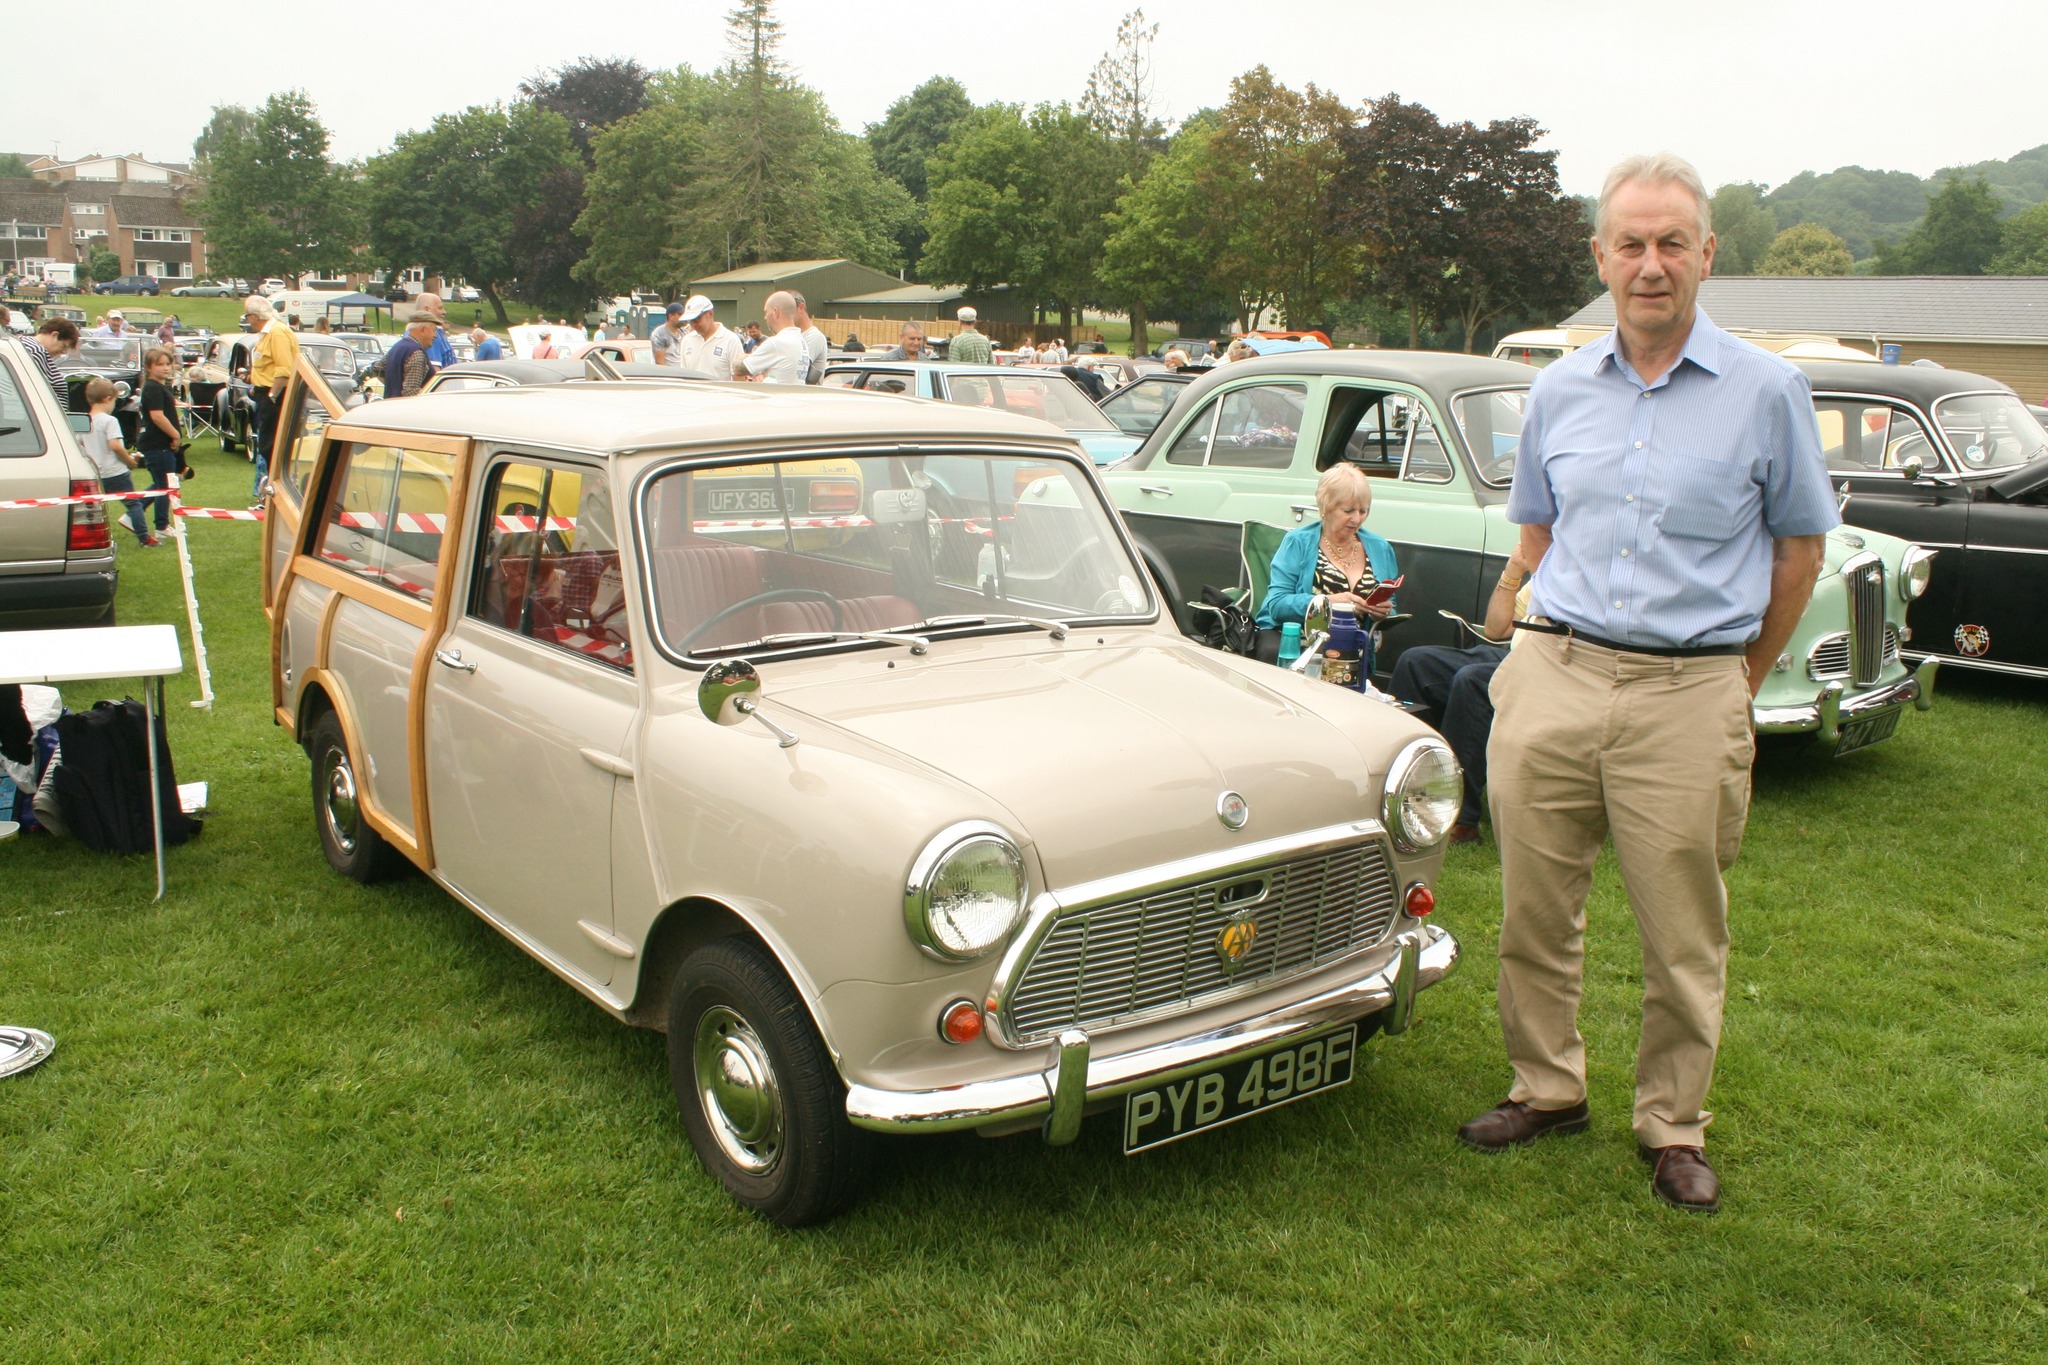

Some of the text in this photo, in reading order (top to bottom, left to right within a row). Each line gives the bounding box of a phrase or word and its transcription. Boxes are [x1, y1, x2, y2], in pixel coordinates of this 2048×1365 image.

[711, 491, 792, 511] UFX 36
[1129, 1031, 1352, 1147] PYB 498F
